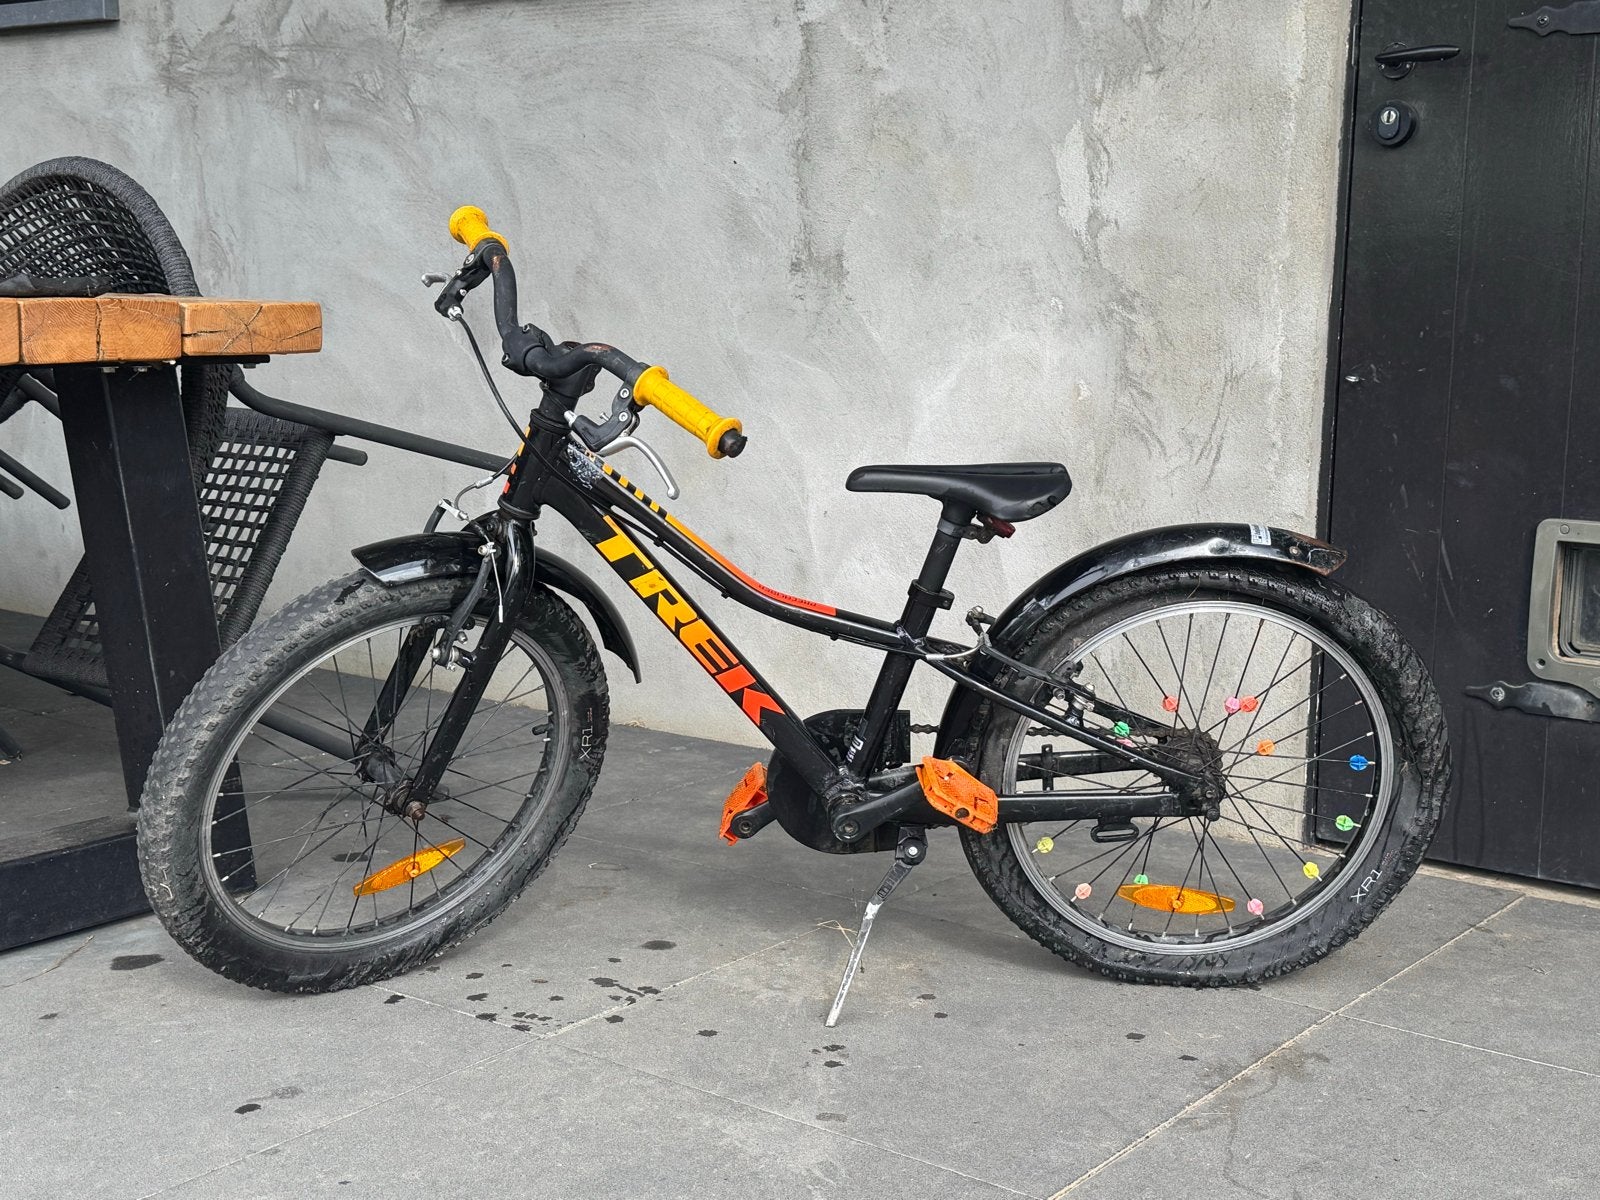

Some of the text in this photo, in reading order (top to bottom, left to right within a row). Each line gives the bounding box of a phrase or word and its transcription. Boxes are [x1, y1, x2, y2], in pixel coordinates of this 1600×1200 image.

[595, 514, 786, 727] TREK
[579, 725, 593, 760] XR1
[1350, 869, 1383, 904] XR1
